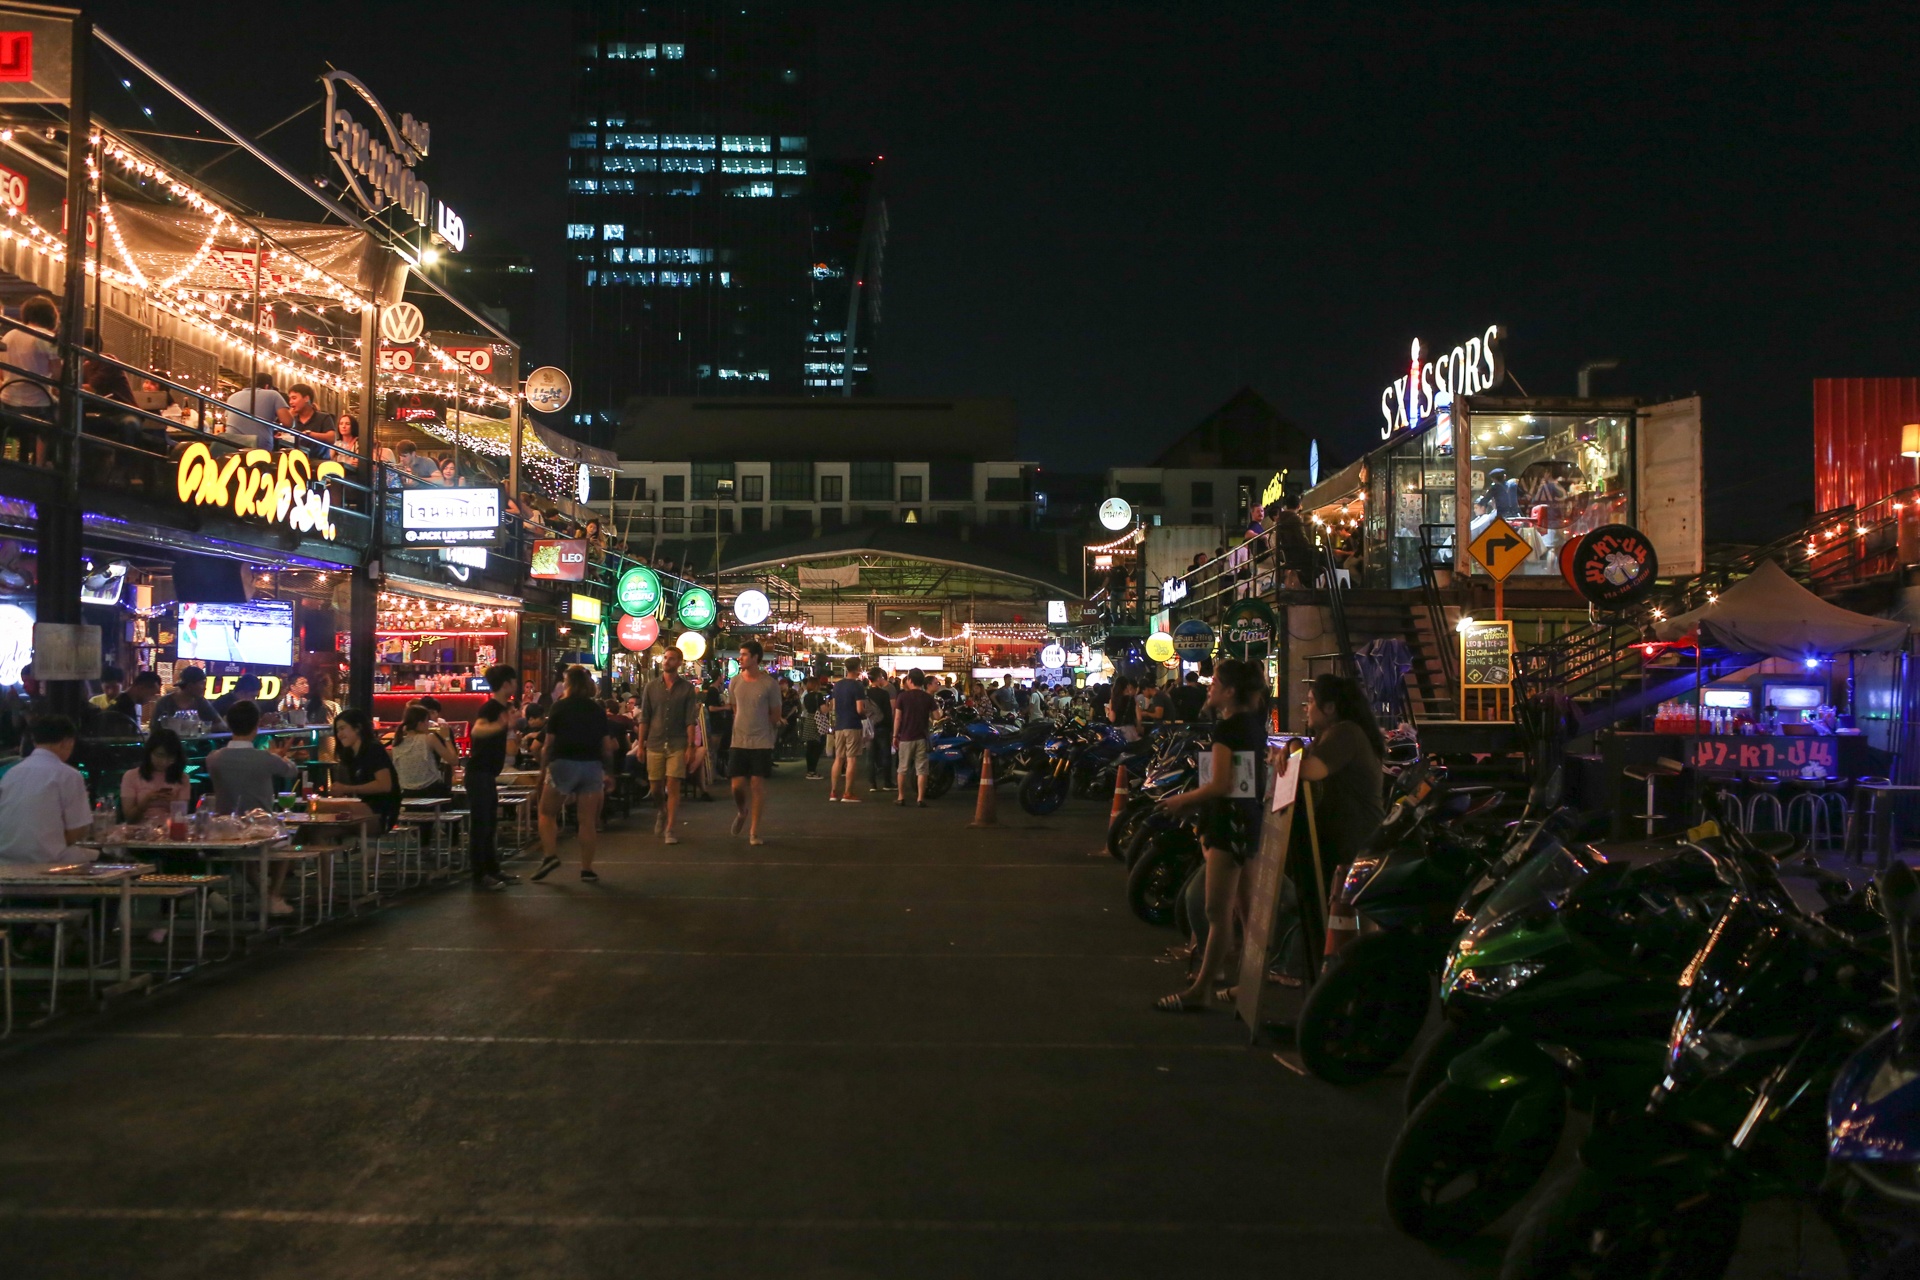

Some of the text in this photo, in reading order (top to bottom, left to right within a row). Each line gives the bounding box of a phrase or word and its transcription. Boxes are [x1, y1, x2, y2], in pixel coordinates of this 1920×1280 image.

[438, 200, 464, 252] LEO
[379, 350, 413, 371] EO
[408, 531, 441, 540] JACK
[561, 553, 583, 563] LEO
[621, 591, 655, 602] Chang
[681, 604, 710, 618] Chang
[1229, 627, 1270, 643] Chang
